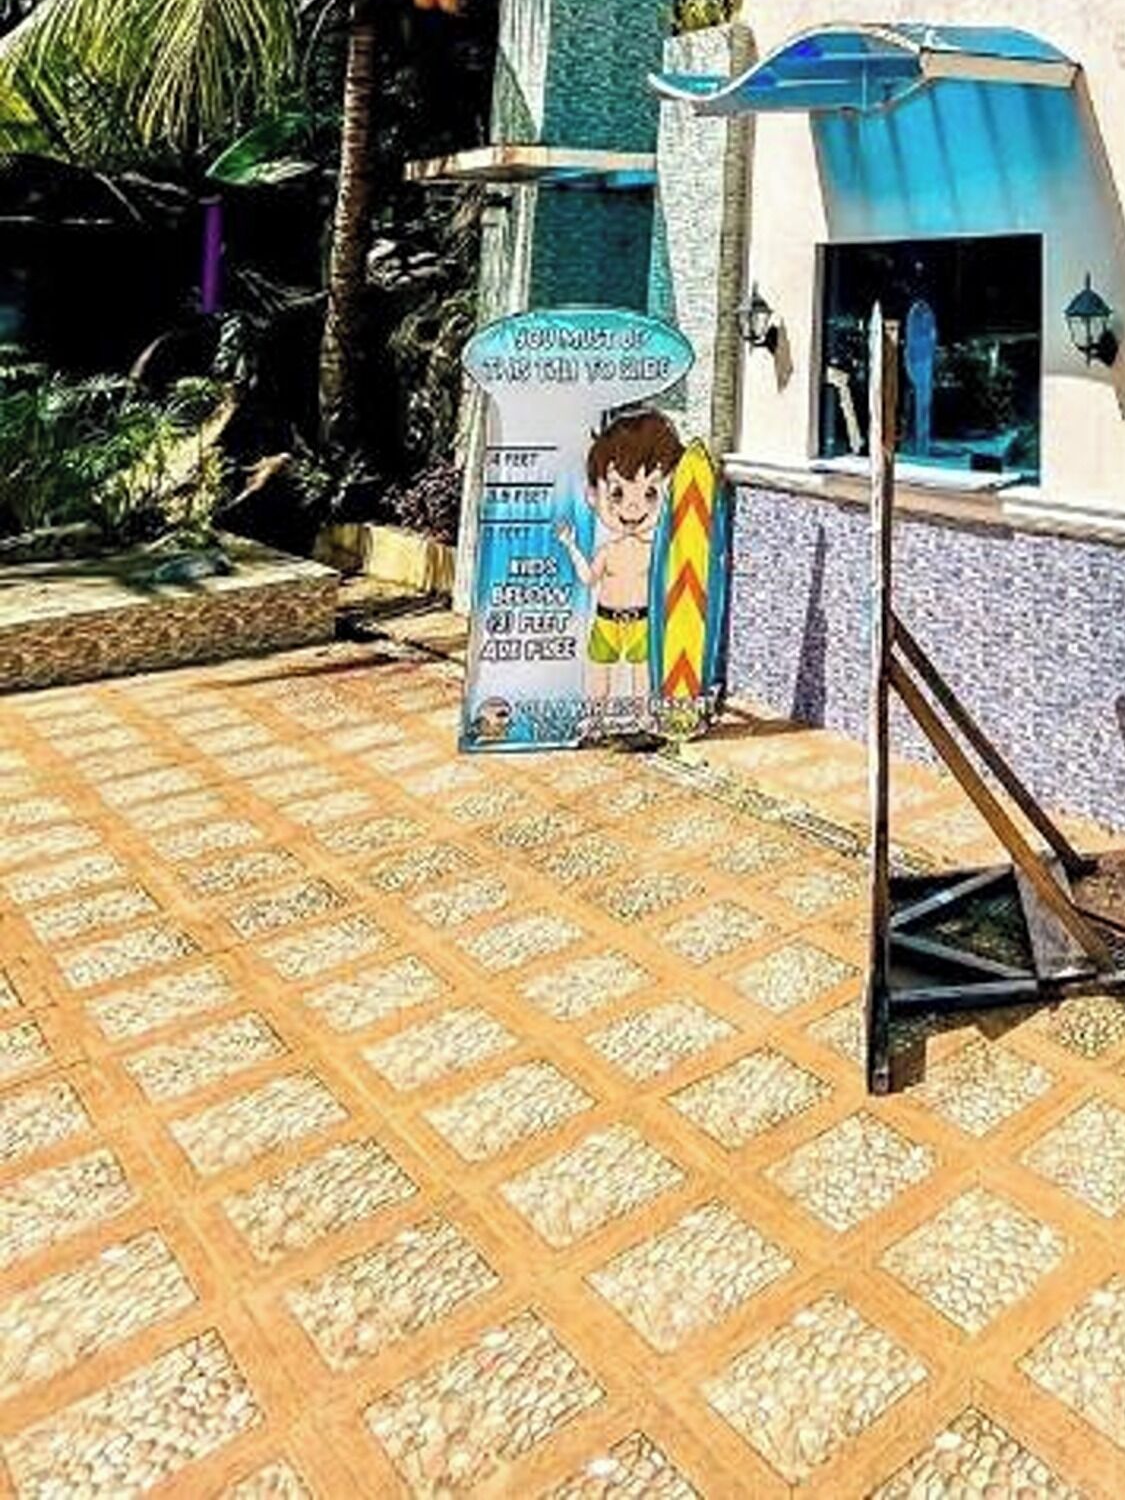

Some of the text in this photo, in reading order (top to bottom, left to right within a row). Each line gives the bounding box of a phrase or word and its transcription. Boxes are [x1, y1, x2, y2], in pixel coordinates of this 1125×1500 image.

[559, 327, 614, 350] MUST
[505, 452, 539, 468] FEET
[514, 489, 549, 504] FEET
[509, 556, 557, 577] KIDS
[491, 583, 573, 607] BELOW
[517, 609, 573, 634] FEET
[480, 636, 577, 662] ARE FREE
